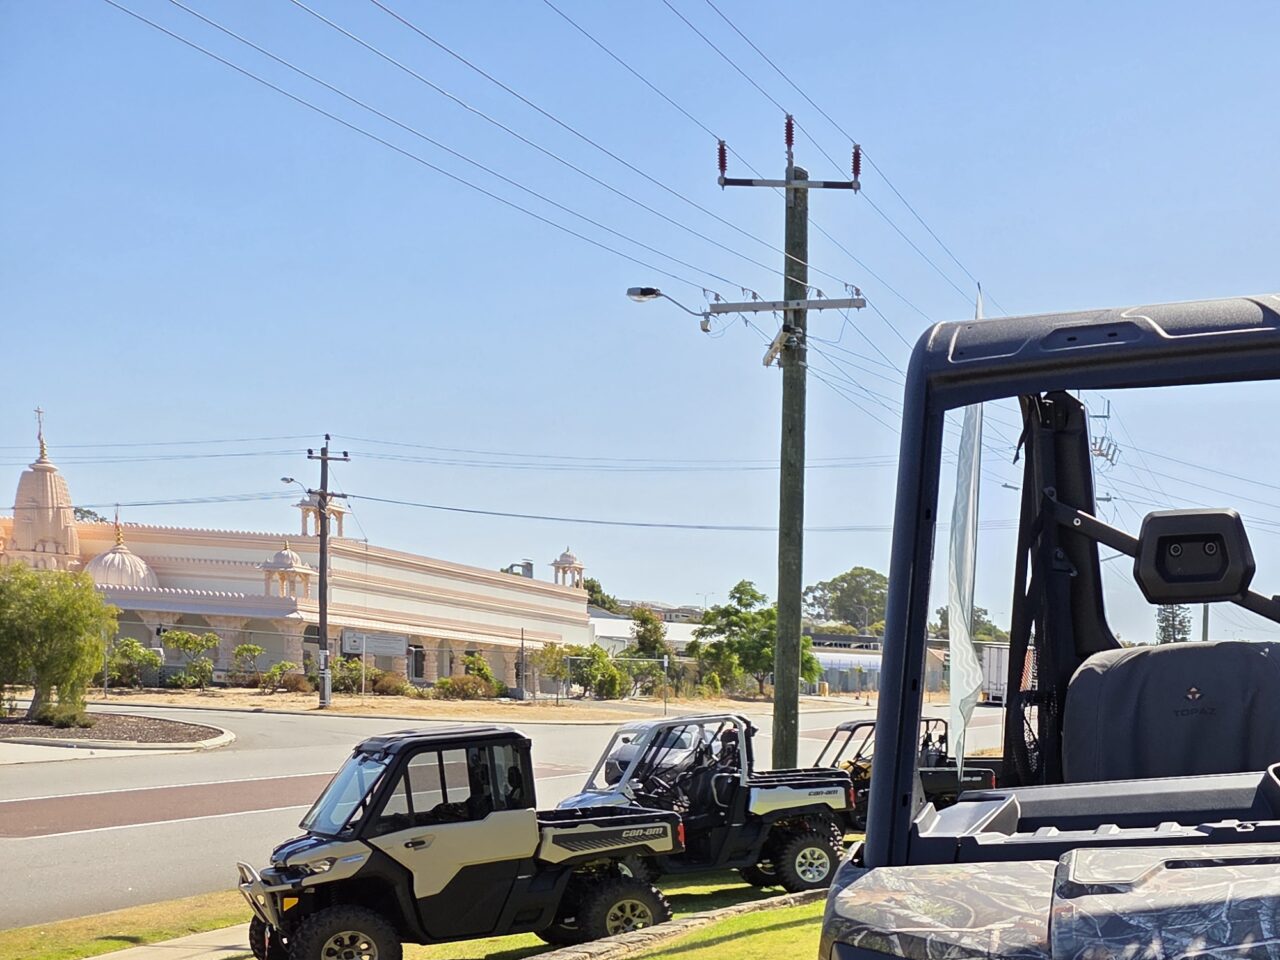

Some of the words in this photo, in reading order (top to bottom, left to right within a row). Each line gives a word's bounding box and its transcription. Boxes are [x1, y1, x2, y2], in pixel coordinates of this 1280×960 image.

[1173, 705, 1216, 717] TOPAZ
[807, 789, 839, 797] can-am
[621, 827, 664, 838] can-am
